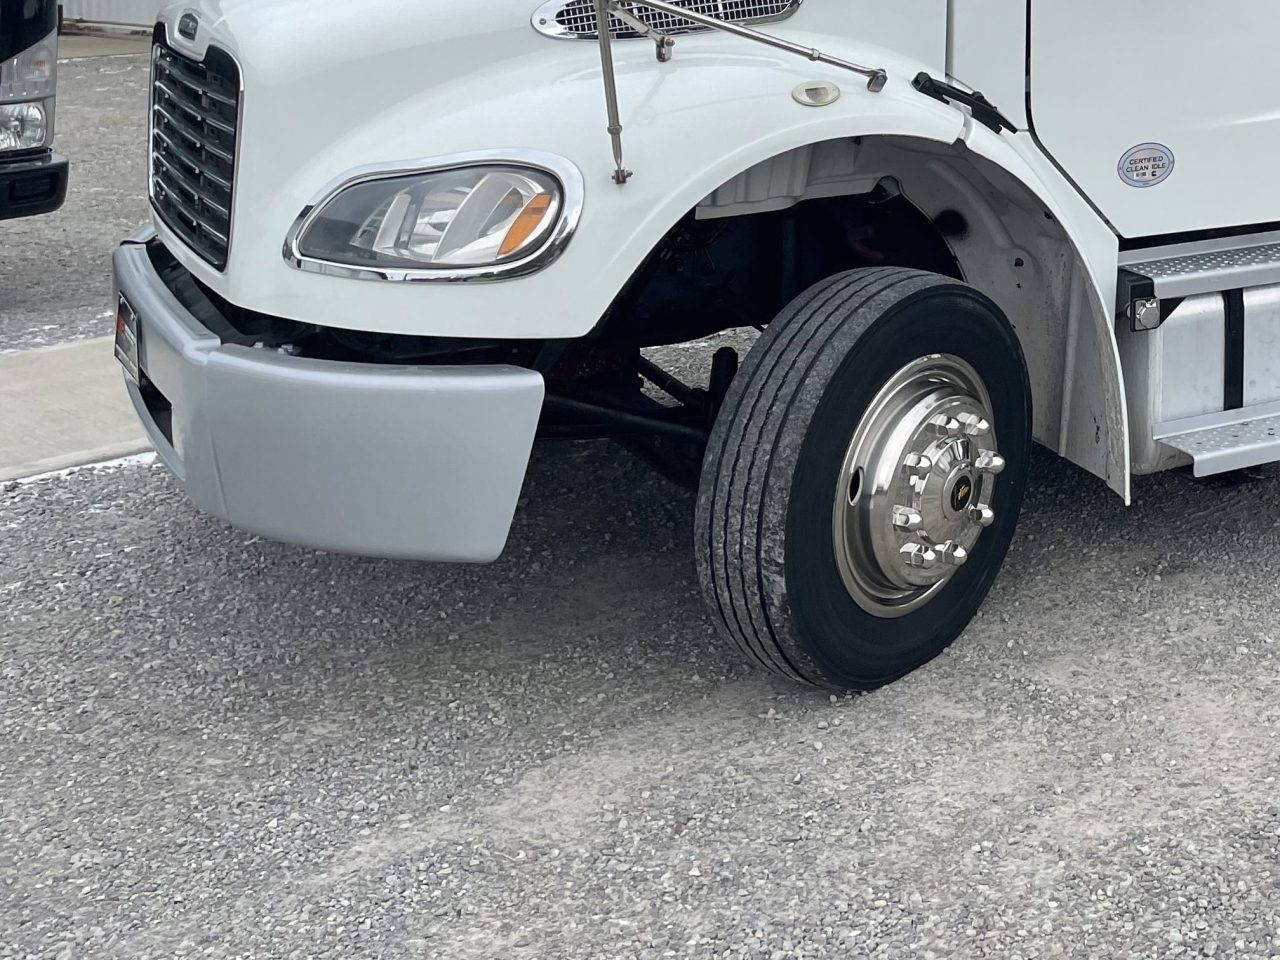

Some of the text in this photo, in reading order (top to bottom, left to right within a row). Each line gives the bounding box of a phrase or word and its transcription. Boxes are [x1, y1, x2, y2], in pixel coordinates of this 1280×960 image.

[1129, 155, 1164, 165] CERTIFIED
[1125, 162, 1167, 173] CLEAN IDLE
